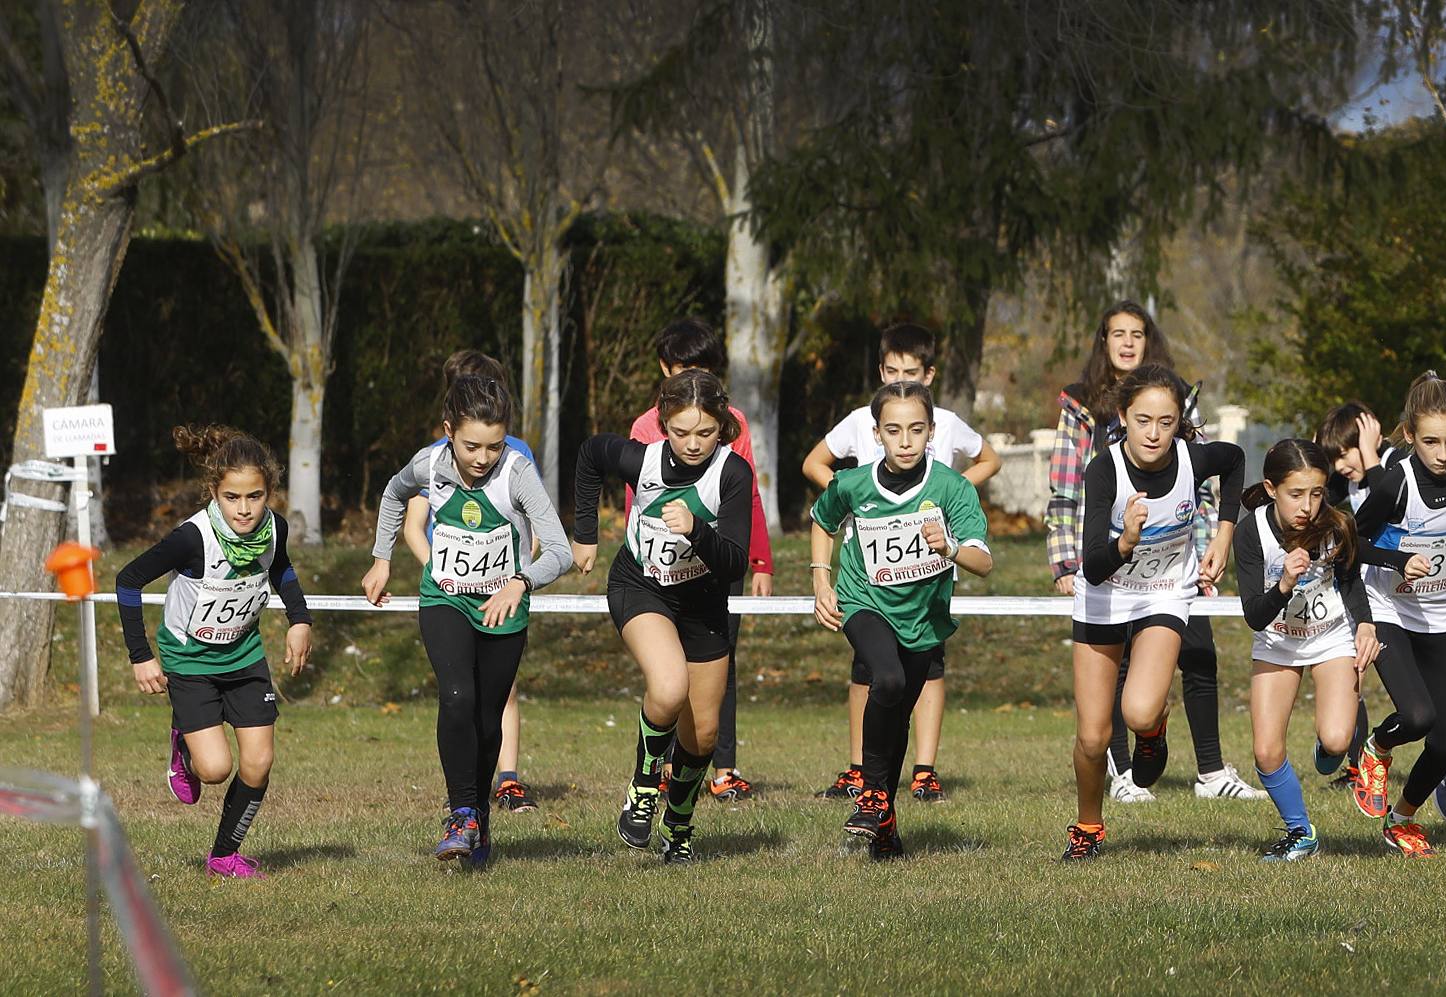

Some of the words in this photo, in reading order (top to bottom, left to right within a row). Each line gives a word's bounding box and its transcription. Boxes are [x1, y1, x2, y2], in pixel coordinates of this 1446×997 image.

[858, 523, 888, 532] Gobierno
[438, 545, 510, 577] 1544
[645, 537, 695, 566] 154
[895, 560, 947, 581] ATLETISMO
[1127, 552, 1181, 579] 137
[203, 583, 233, 593] Gobierno
[201, 590, 269, 624] 1543
